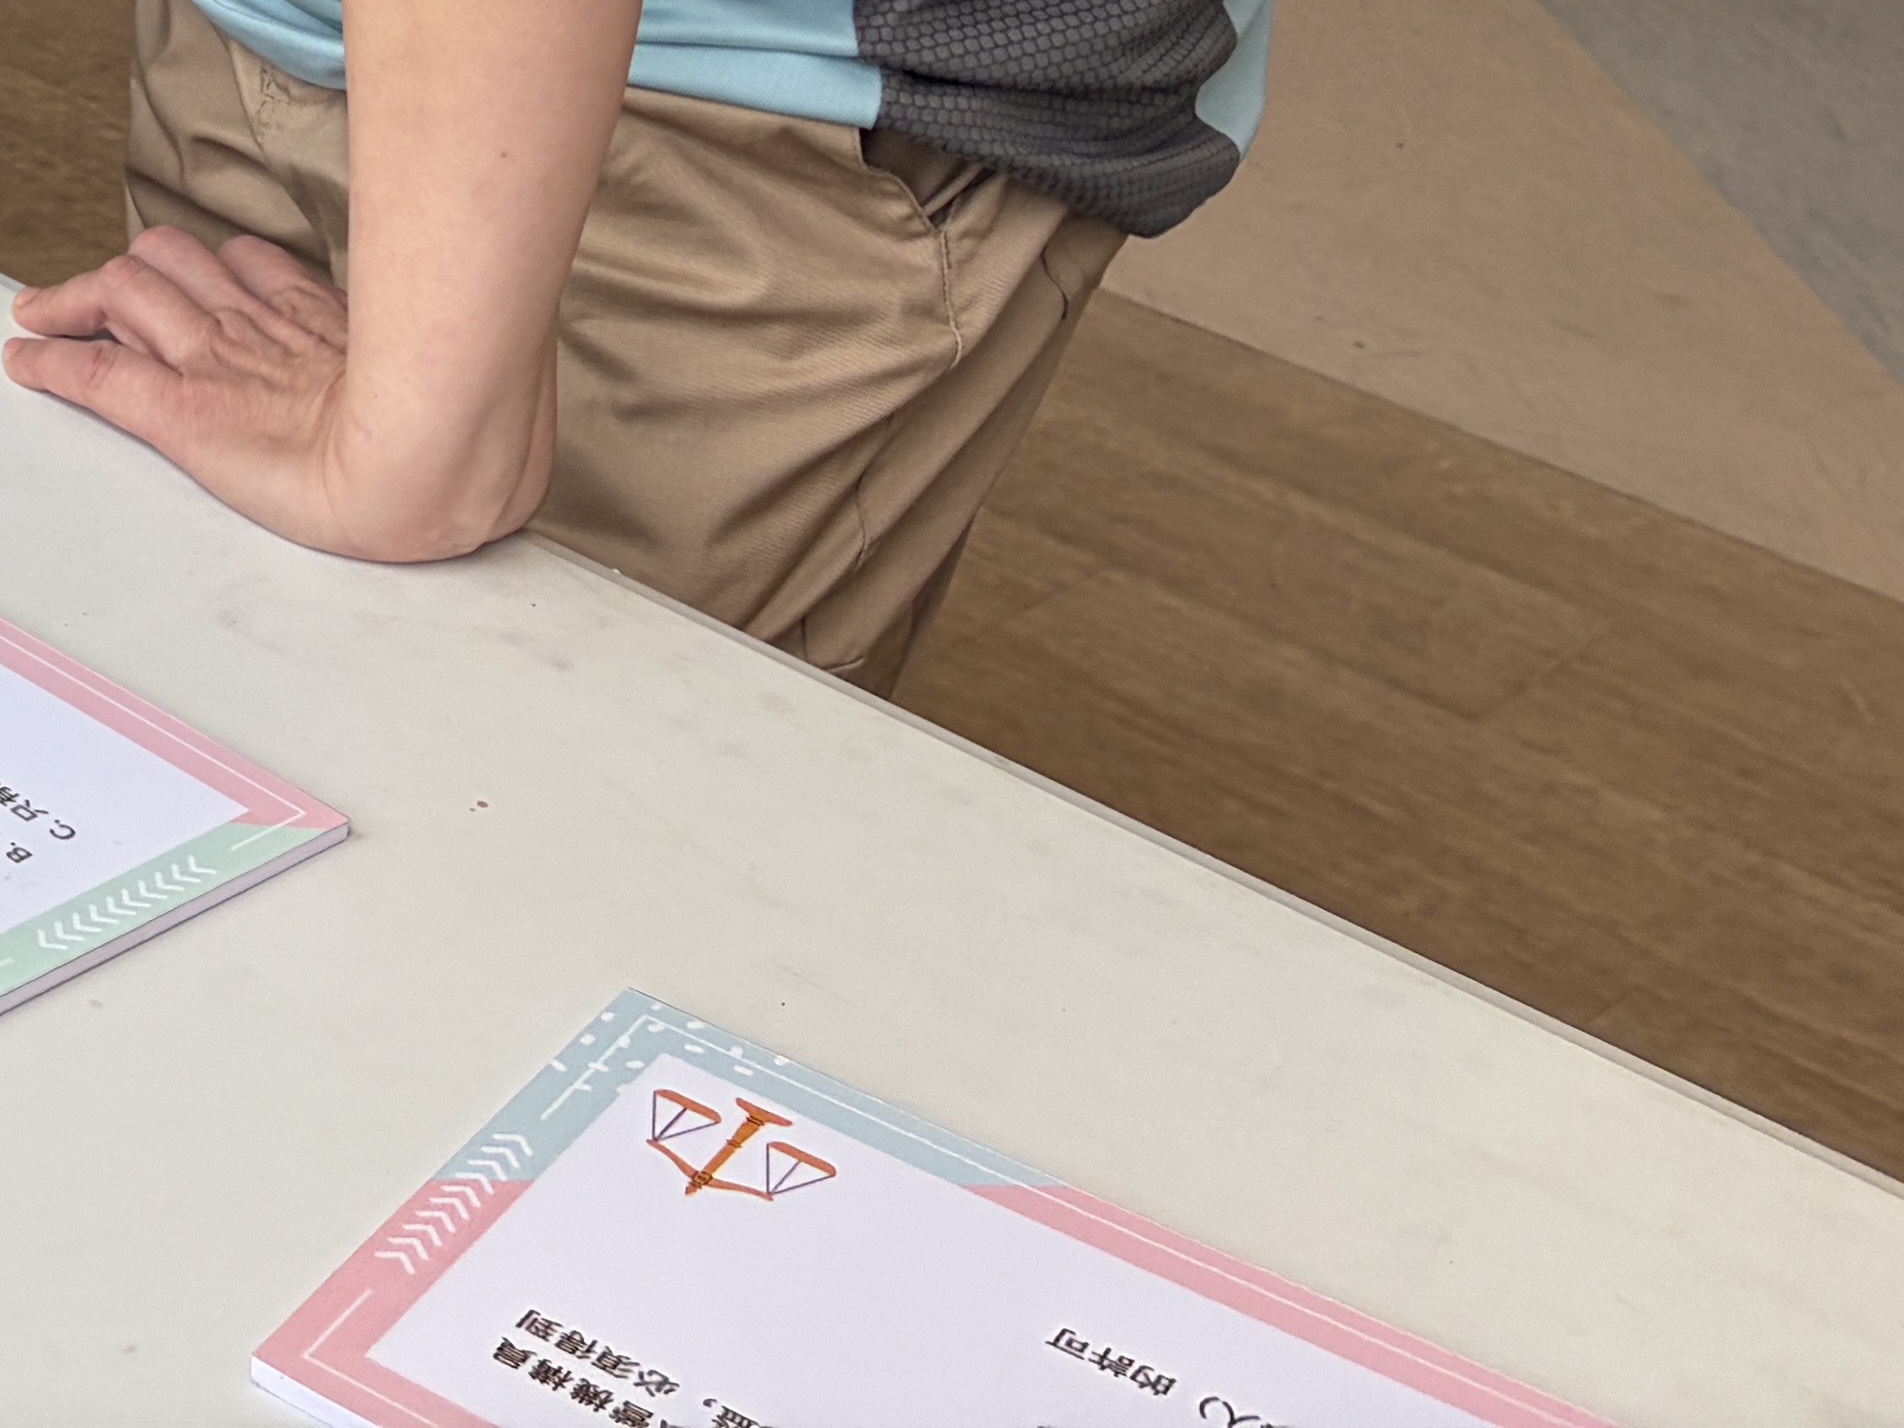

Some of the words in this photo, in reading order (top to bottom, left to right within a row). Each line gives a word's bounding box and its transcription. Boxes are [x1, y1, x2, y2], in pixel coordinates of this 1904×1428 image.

[5, 841, 33, 864] B.
[49, 819, 76, 841] C.
[491, 1335, 679, 1428] 營機構員
[514, 1308, 773, 1428] 益，必須得到
[1046, 1325, 1284, 1428] 人）的許可
